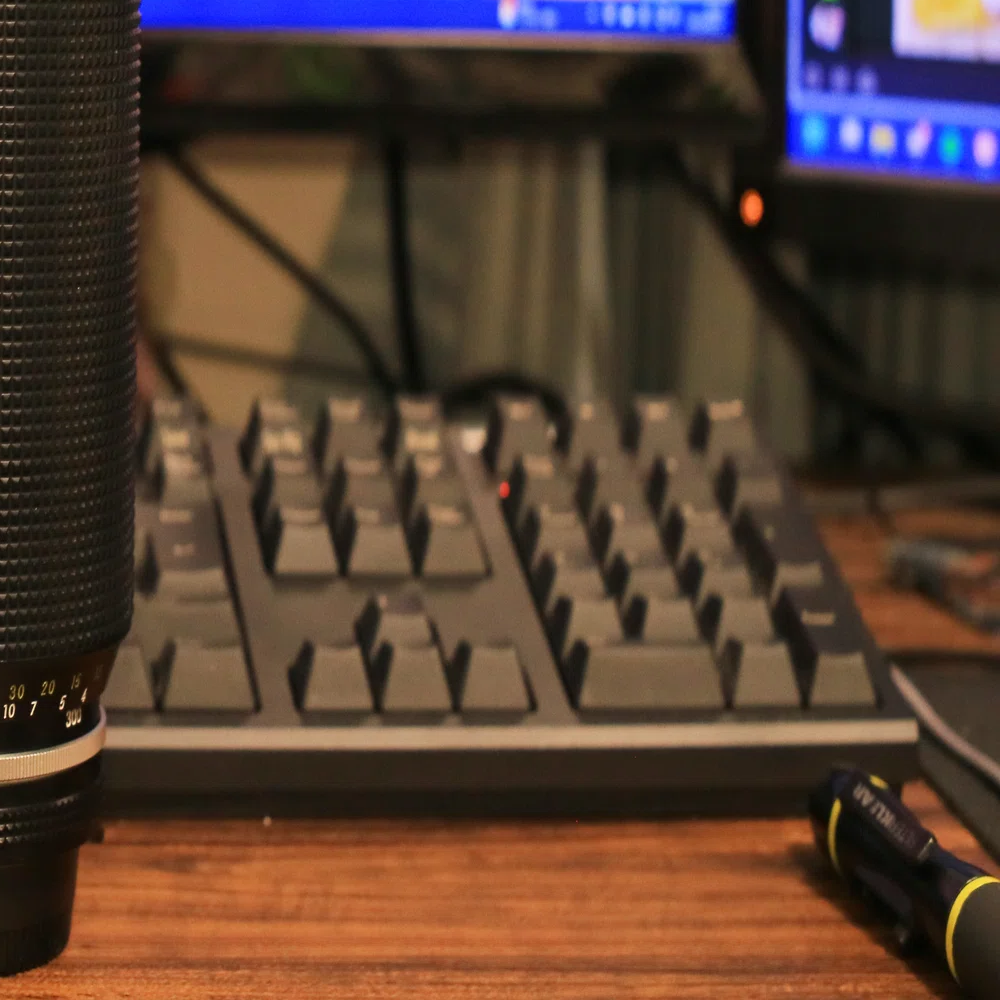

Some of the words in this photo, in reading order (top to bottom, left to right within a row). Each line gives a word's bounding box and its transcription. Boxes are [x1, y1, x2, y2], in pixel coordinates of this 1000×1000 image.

[8, 683, 25, 700] 30
[41, 680, 56, 696] 20
[70, 672, 82, 690] 15
[3, 703, 16, 720] 10
[29, 700, 38, 717] 7
[59, 694, 67, 711] 5
[66, 708, 82, 729] 300
